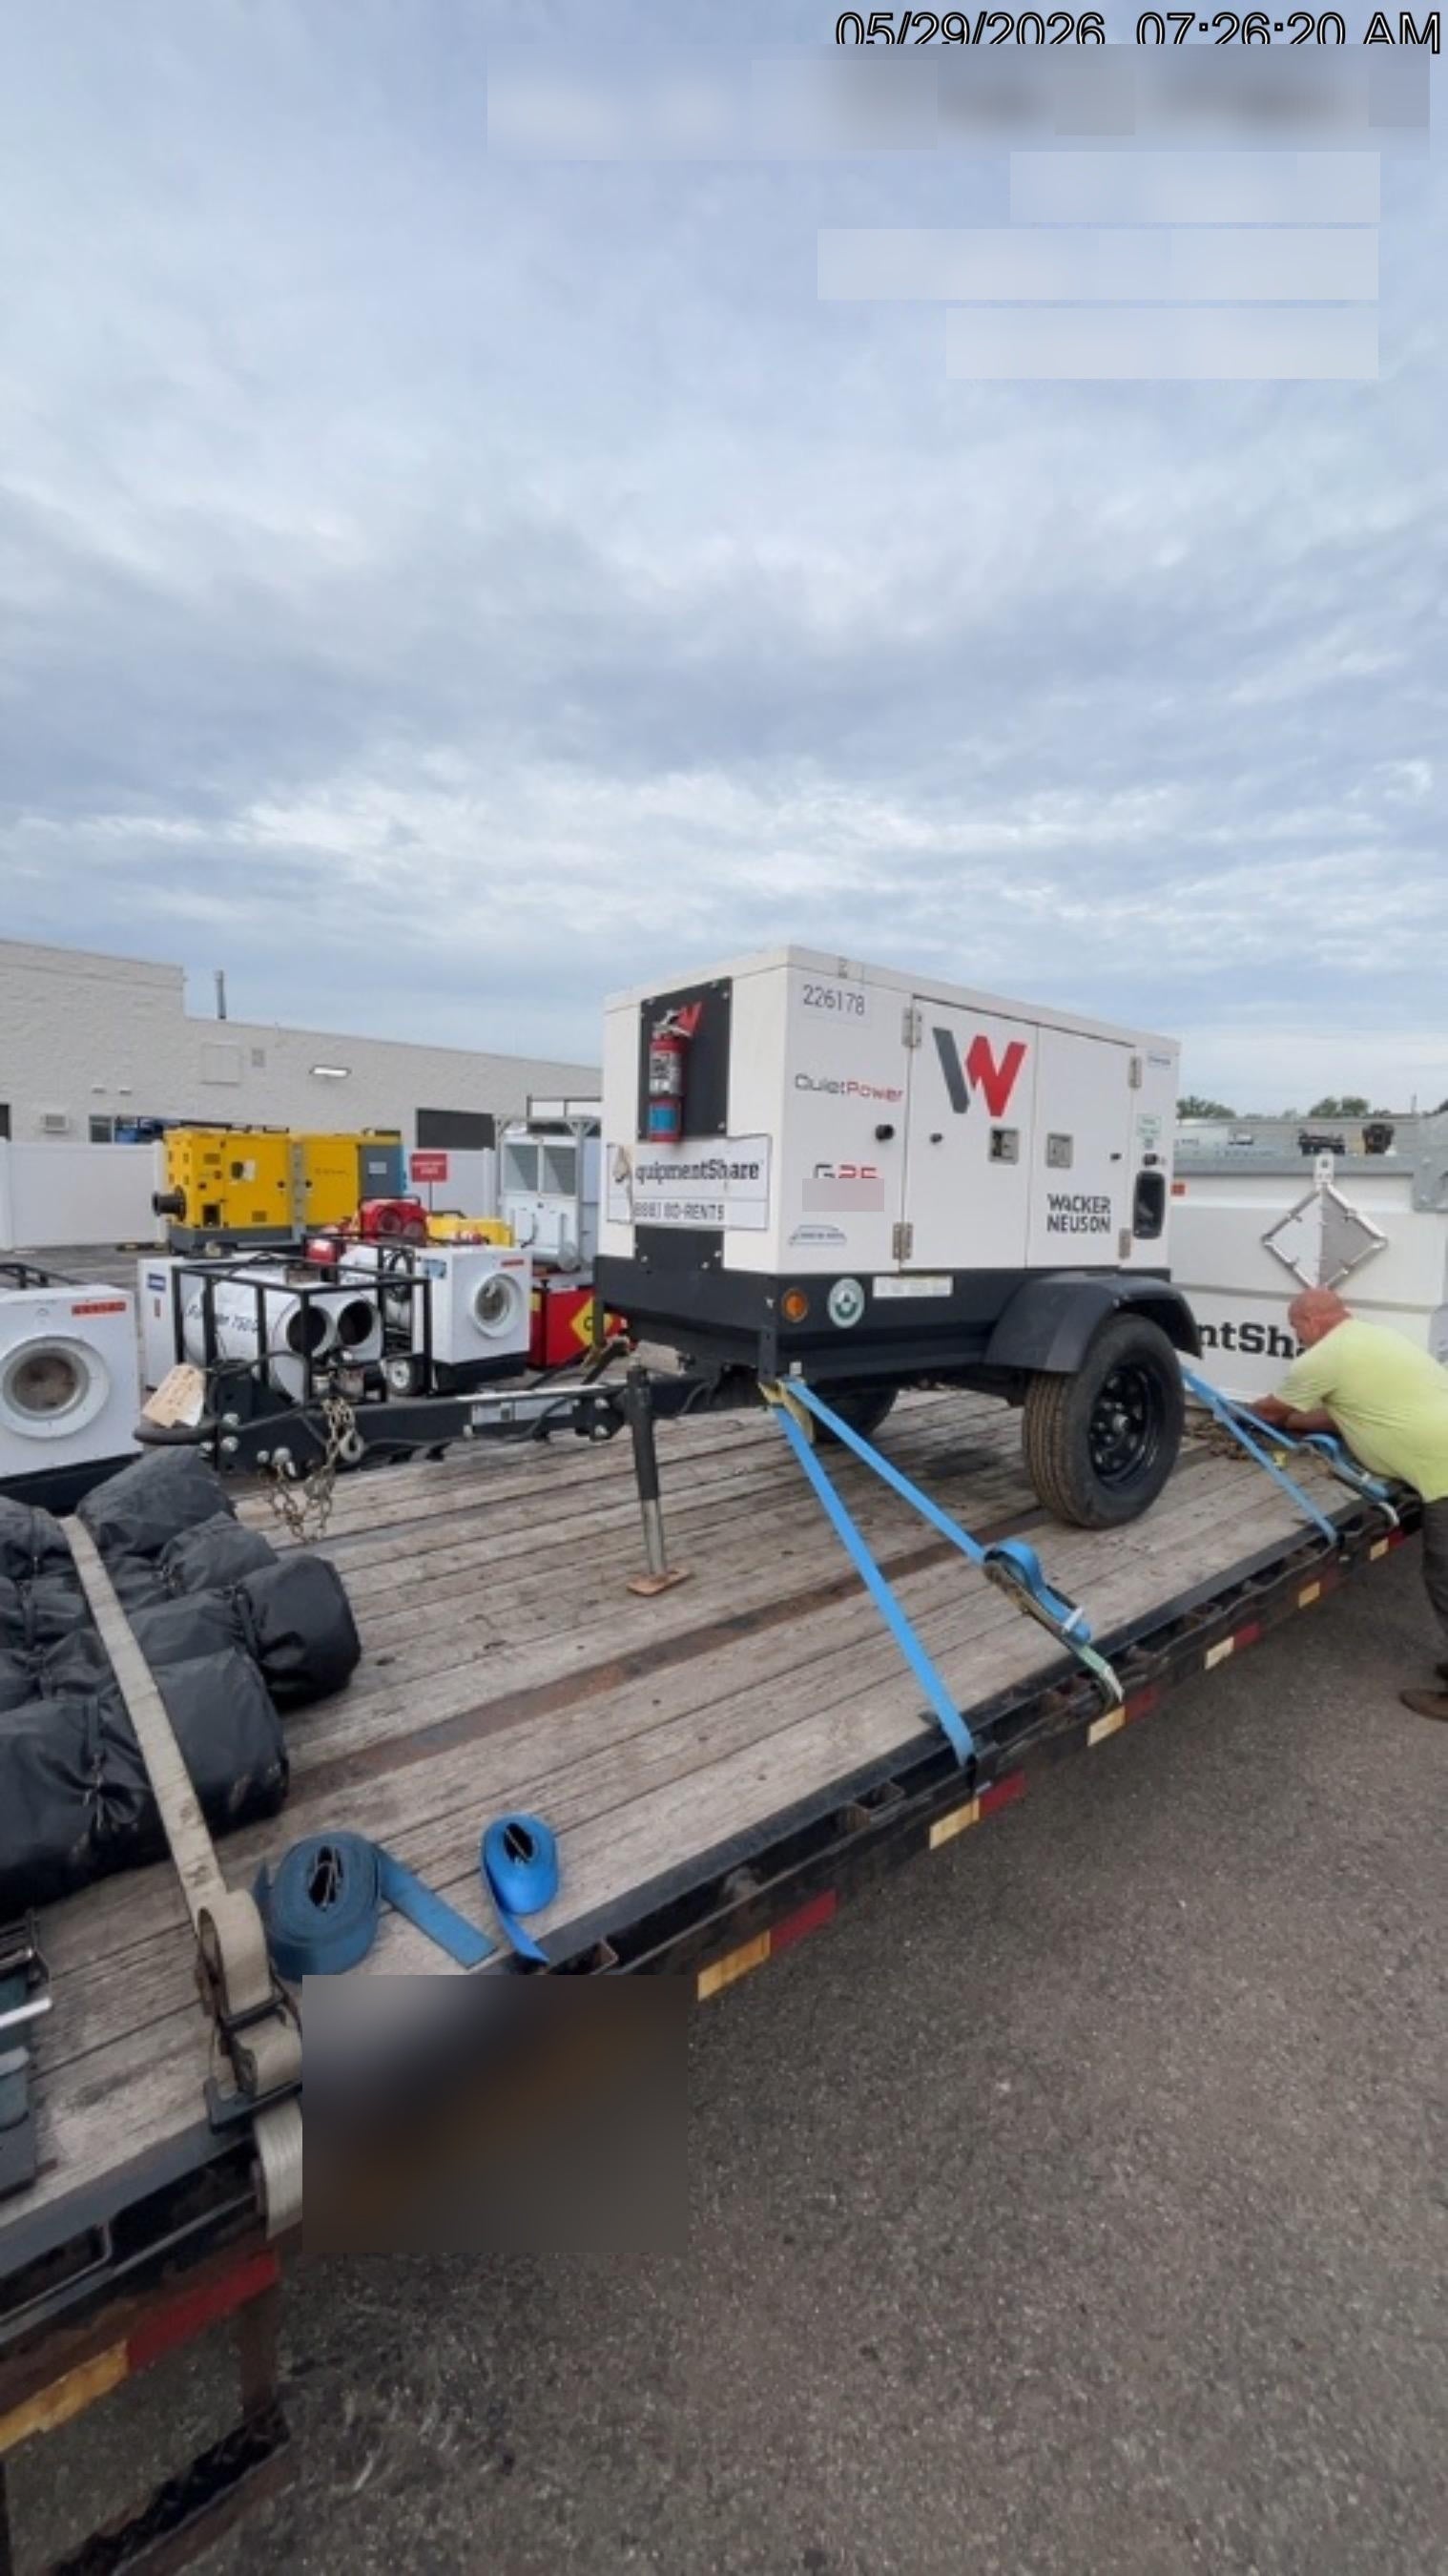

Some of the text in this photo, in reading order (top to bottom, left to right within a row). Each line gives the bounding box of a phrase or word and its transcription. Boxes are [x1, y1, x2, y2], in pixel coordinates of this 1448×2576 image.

[803, 984, 865, 1016] 226178
[1047, 1194, 1111, 1214] WACKER
[1047, 1215, 1111, 1234] NEUSON
[1198, 1321, 1306, 1360] ntSh
